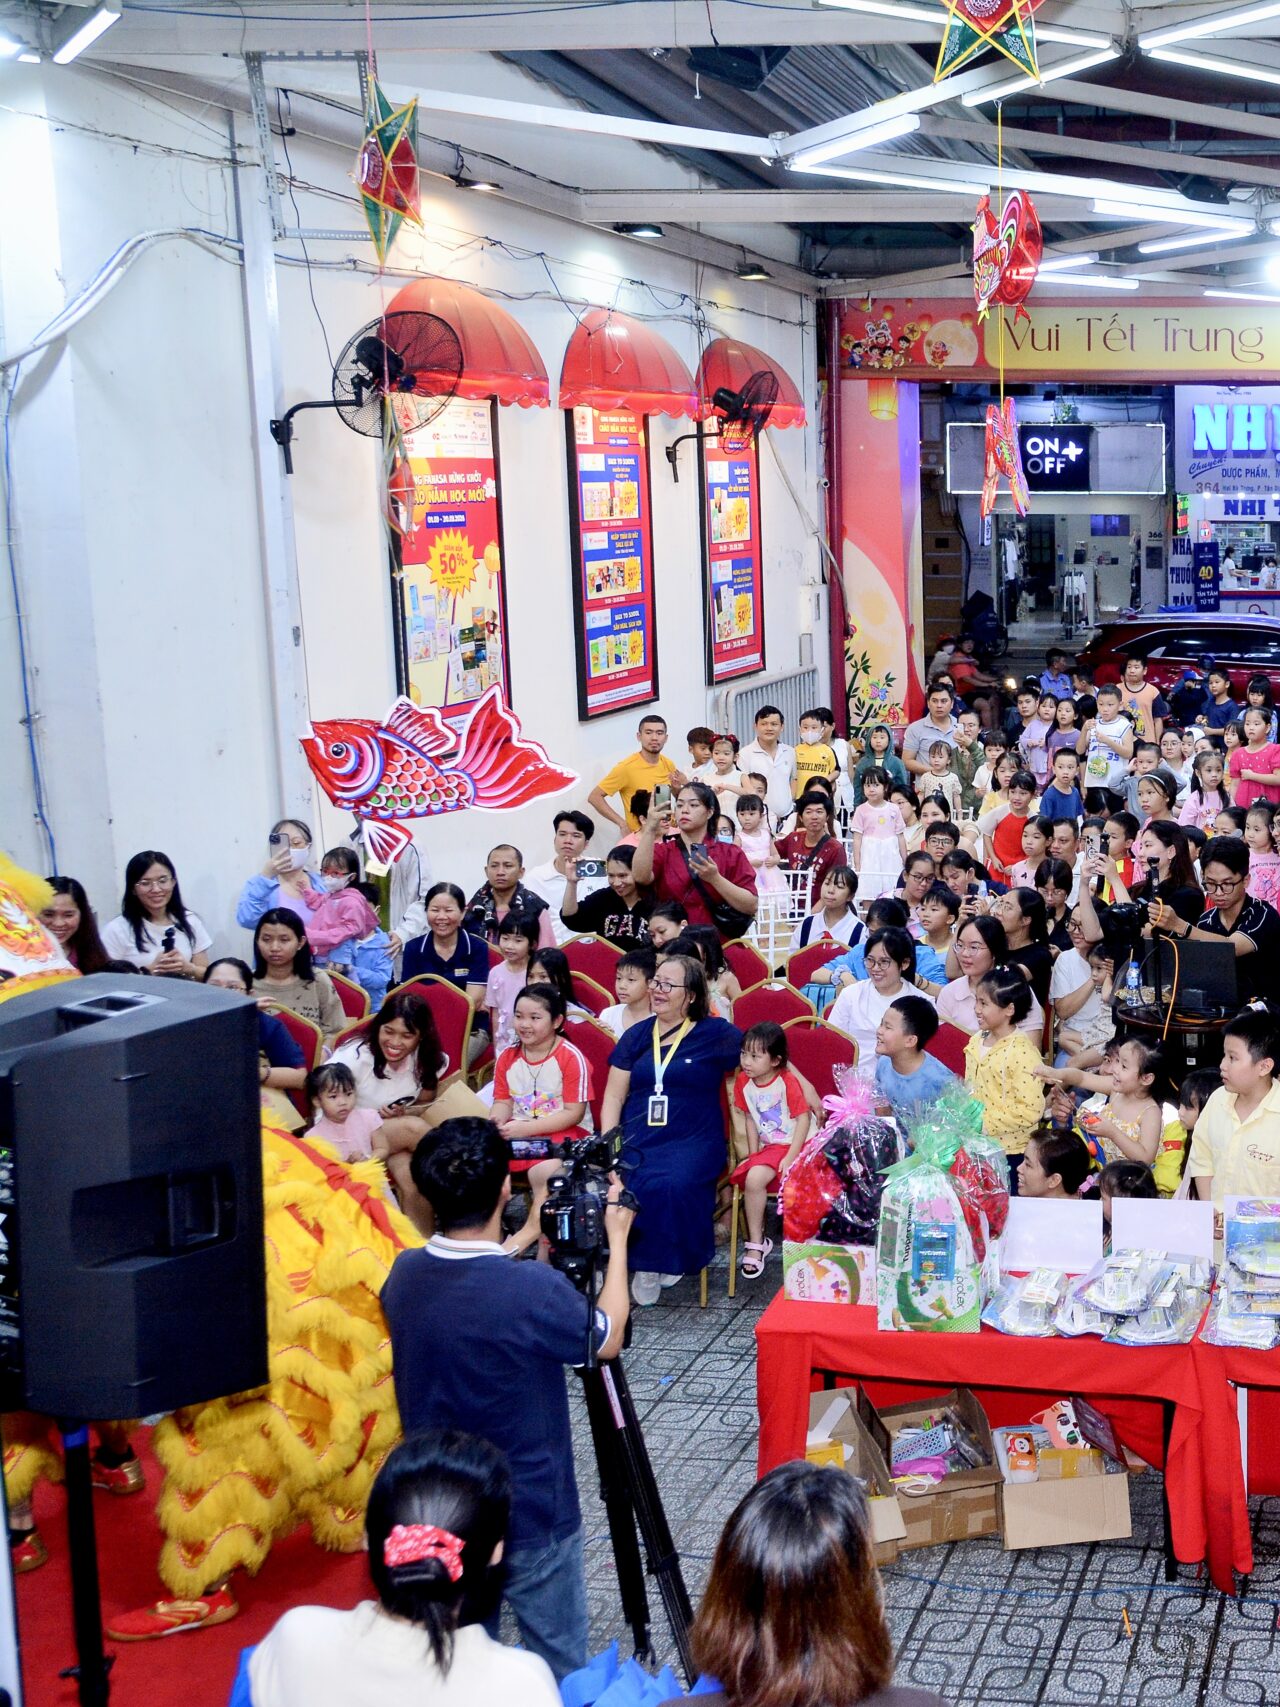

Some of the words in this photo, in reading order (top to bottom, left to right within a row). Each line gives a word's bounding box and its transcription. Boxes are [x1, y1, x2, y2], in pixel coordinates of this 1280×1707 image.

[1003, 316, 1061, 353] Vui
[1076, 312, 1138, 353] Tết
[1153, 316, 1265, 364] Trung
[1026, 436, 1060, 456] ON
[1026, 456, 1066, 475] OFF
[1221, 467, 1243, 480] DƯỢC
[1245, 464, 1271, 479] PHẨM,
[1195, 482, 1220, 495] 364
[1223, 499, 1266, 520] NHỊ
[1147, 531, 1163, 539] 366
[1172, 536, 1193, 556] NHÀ
[1198, 565, 1214, 580] 40
[798, 1267, 807, 1299] protex
[957, 1274, 965, 1308] protex
